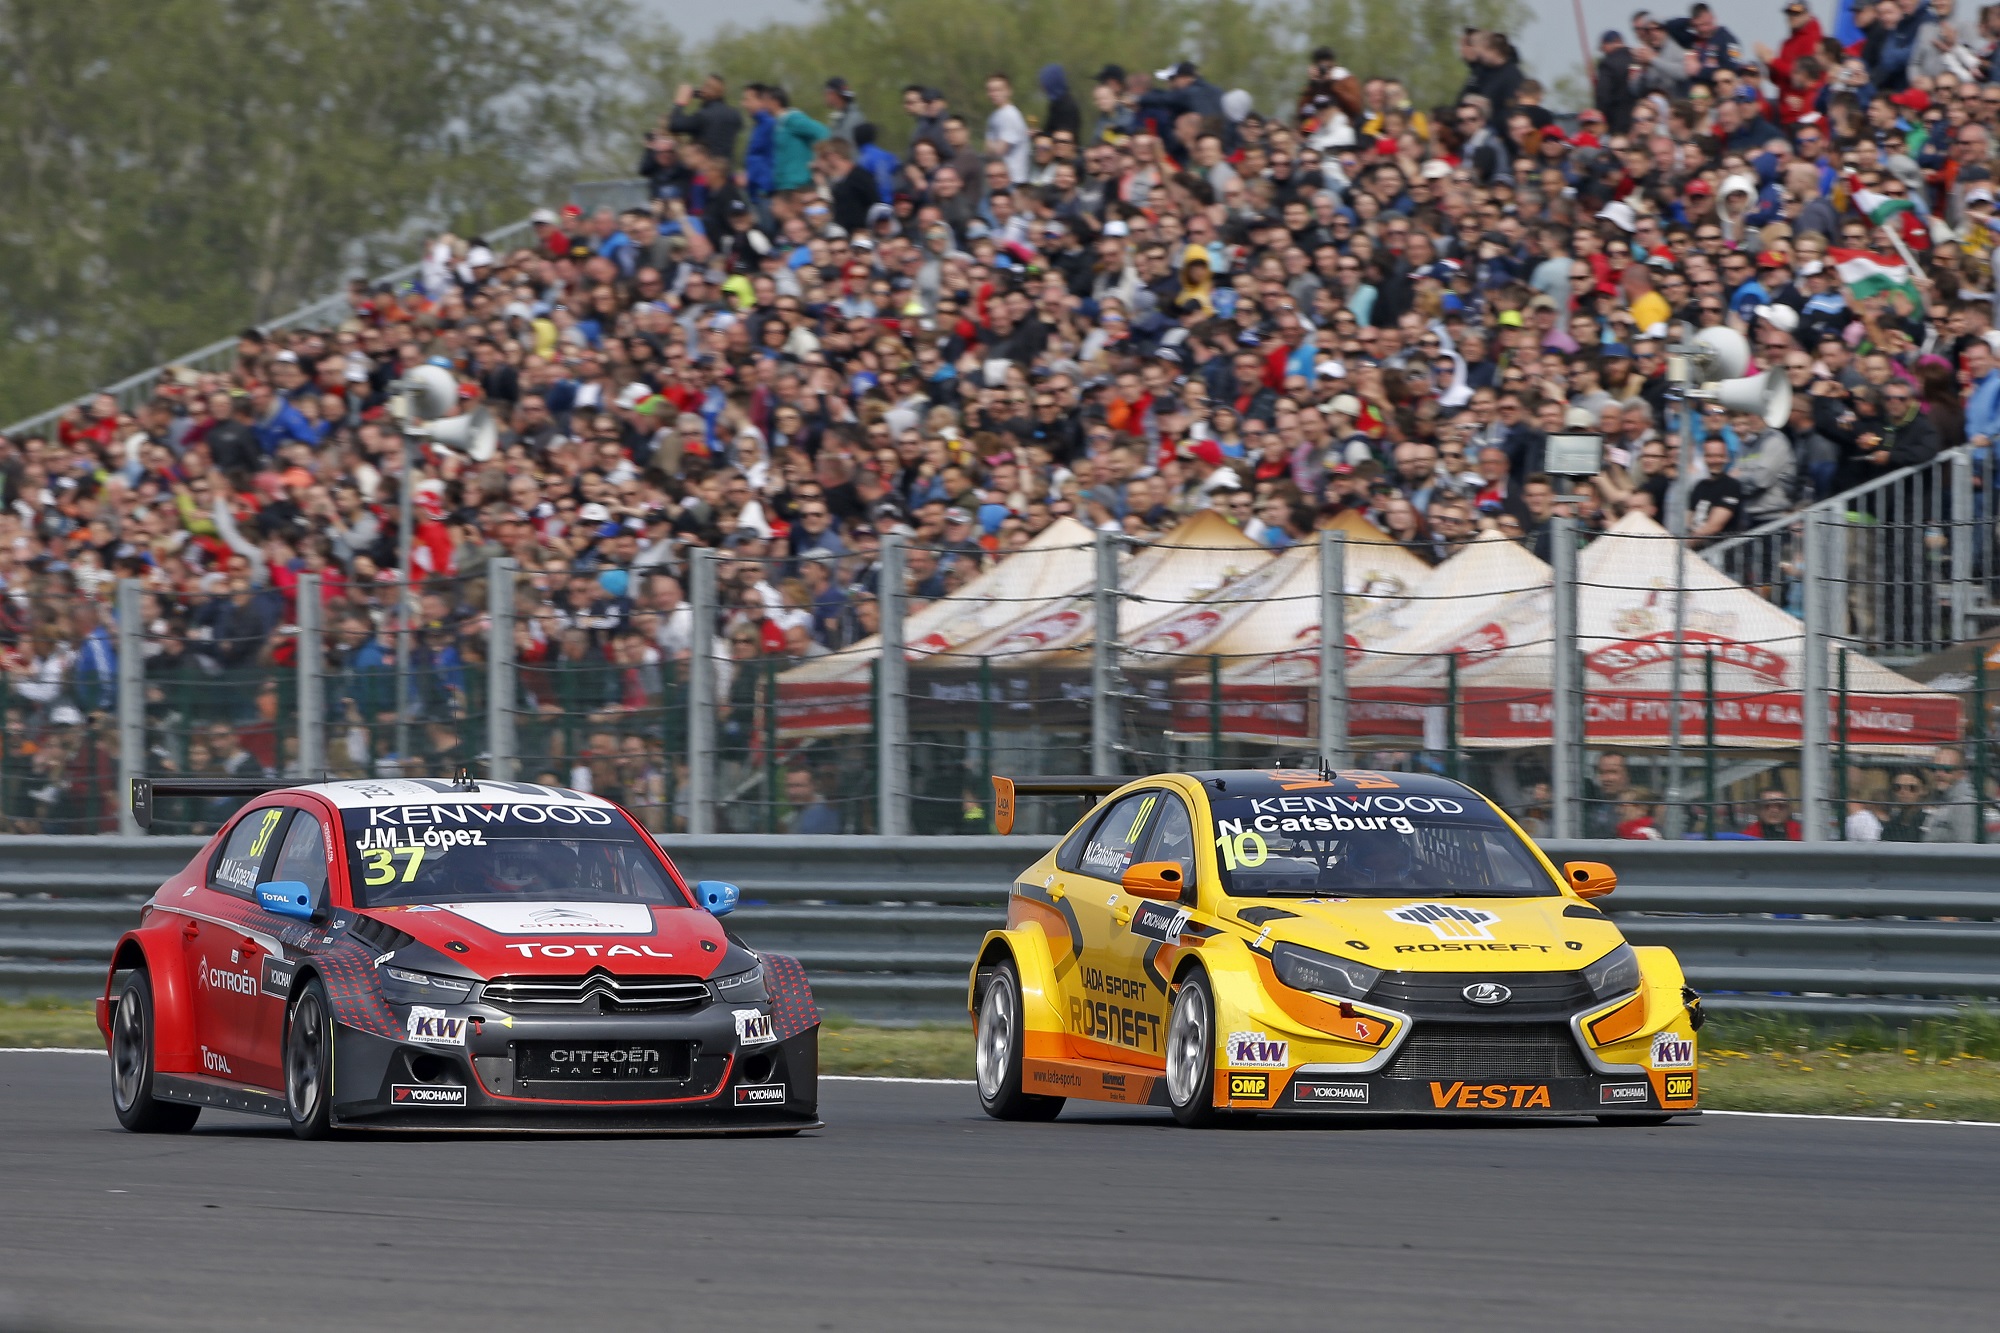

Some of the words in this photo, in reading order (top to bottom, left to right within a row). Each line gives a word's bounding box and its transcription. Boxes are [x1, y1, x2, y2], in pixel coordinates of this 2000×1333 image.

[369, 804, 612, 826] KENWOOD
[1251, 795, 1464, 815] KENWOOD
[1124, 797, 1156, 844] 10
[249, 809, 283, 857] 37
[356, 827, 404, 850] J.M.
[407, 825, 488, 852] López
[1216, 832, 1268, 872] 10
[362, 846, 425, 886] 37
[261, 891, 290, 903] TOTAL
[1142, 911, 1171, 931] YOKOHAMA
[505, 943, 673, 959] TOTAL
[1395, 943, 1552, 954] ROSNEFT
[209, 968, 257, 997] CITROËN
[1080, 966, 1105, 993] LADA
[1105, 974, 1147, 1002] SPORT
[415, 1017, 465, 1039] KW
[744, 1016, 771, 1039] KW
[1069, 996, 1161, 1053] ROSNEFT
[411, 1036, 461, 1045] kwsuspensions.de
[200, 1045, 232, 1074] TOTAL
[1236, 1041, 1286, 1061] KW
[1658, 1042, 1692, 1062] KW
[550, 1066, 659, 1074] RACING
[1033, 1070, 1082, 1088] www.lada-sport.ru
[411, 1089, 462, 1101] YOKOHAMA
[748, 1089, 783, 1100] YOKOHAMA
[1231, 1079, 1266, 1094] OMP
[1313, 1087, 1365, 1099] YOKOHAMA
[1429, 1081, 1551, 1109] VESTA
[1612, 1087, 1645, 1099] YOKOHAMA
[1667, 1080, 1692, 1094] OMP
